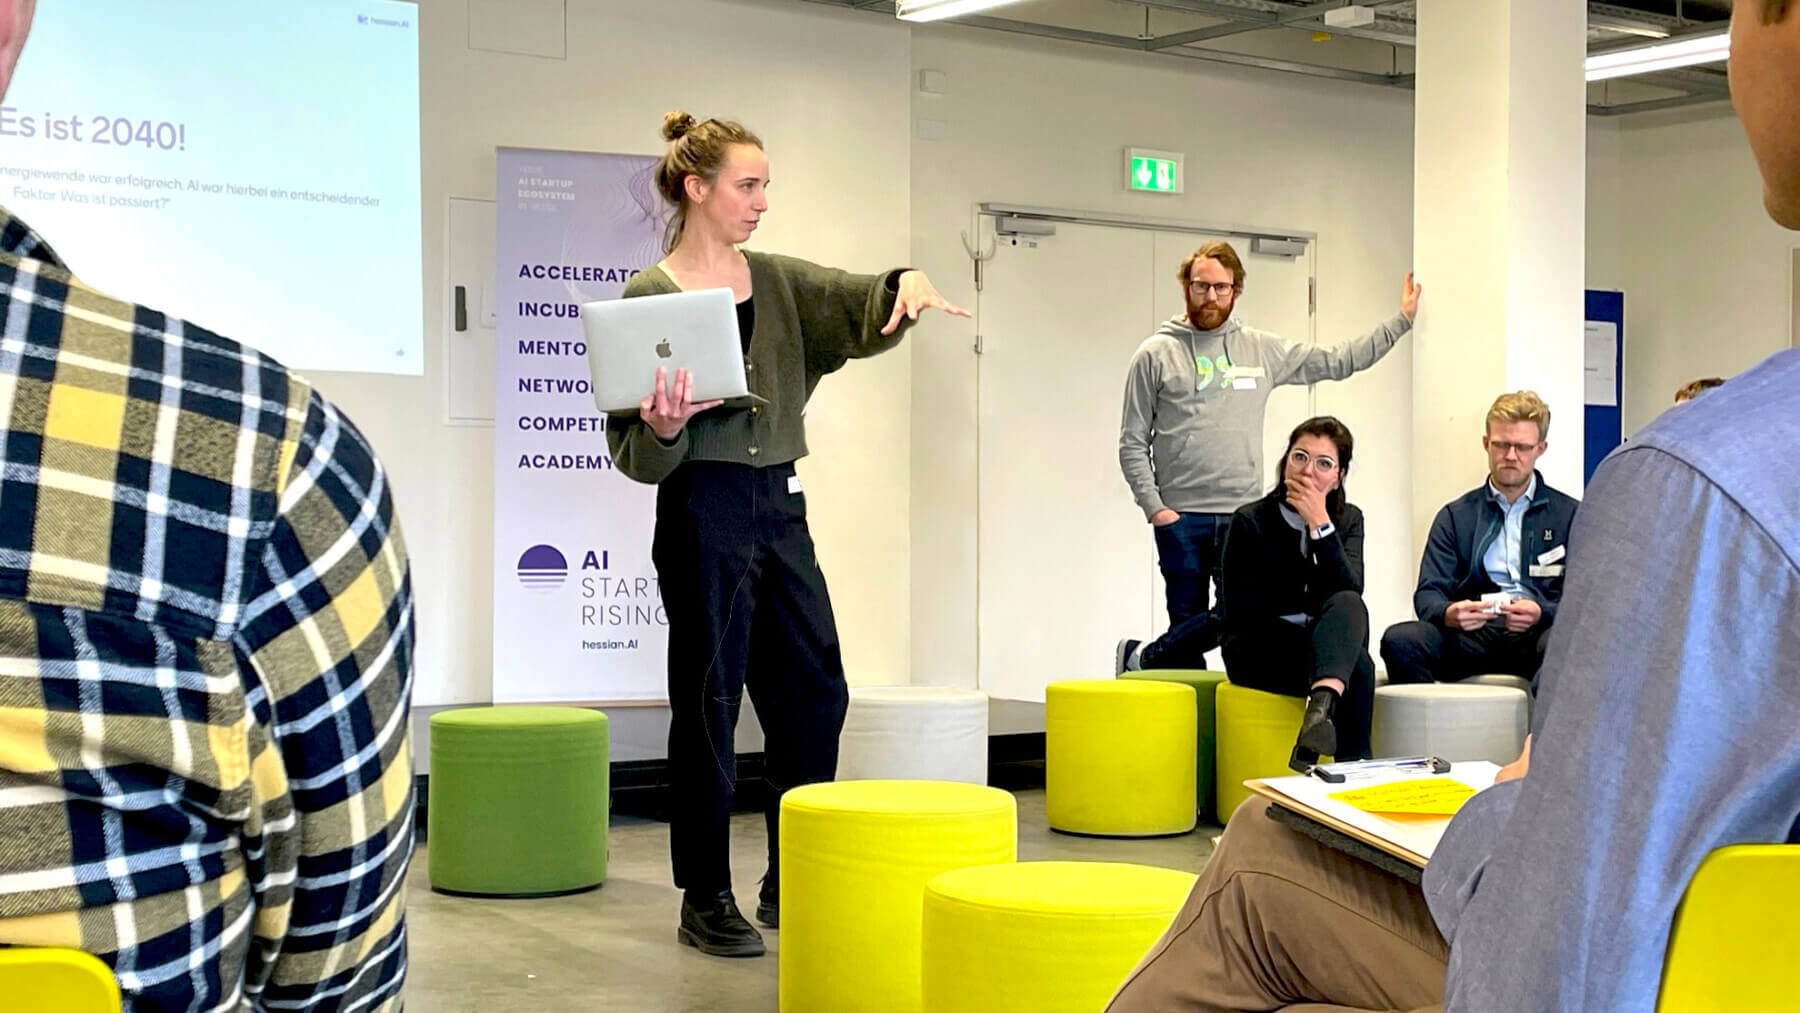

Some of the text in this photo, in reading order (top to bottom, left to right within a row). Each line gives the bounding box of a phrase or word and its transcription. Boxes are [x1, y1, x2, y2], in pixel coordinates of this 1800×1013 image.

[0, 106, 185, 151] Es ist 2040!
[89, 173, 112, 185] war
[201, 183, 224, 194] war
[226, 183, 268, 197] hierbei
[270, 187, 288, 199] ein
[290, 189, 380, 207] entscheidender
[519, 177, 574, 188] AI STARTUP
[60, 190, 89, 204] Was
[91, 192, 106, 205] ist
[518, 189, 576, 200] ECOSYSTEM
[518, 302, 582, 319] INCUB
[518, 340, 587, 356] MENTO
[518, 378, 594, 394] NETWO
[518, 416, 605, 432] COMPETI
[518, 454, 613, 470] ACADEMY
[581, 550, 609, 570] AI
[581, 605, 670, 626] RISING
[582, 639, 638, 650] hessian.AI
